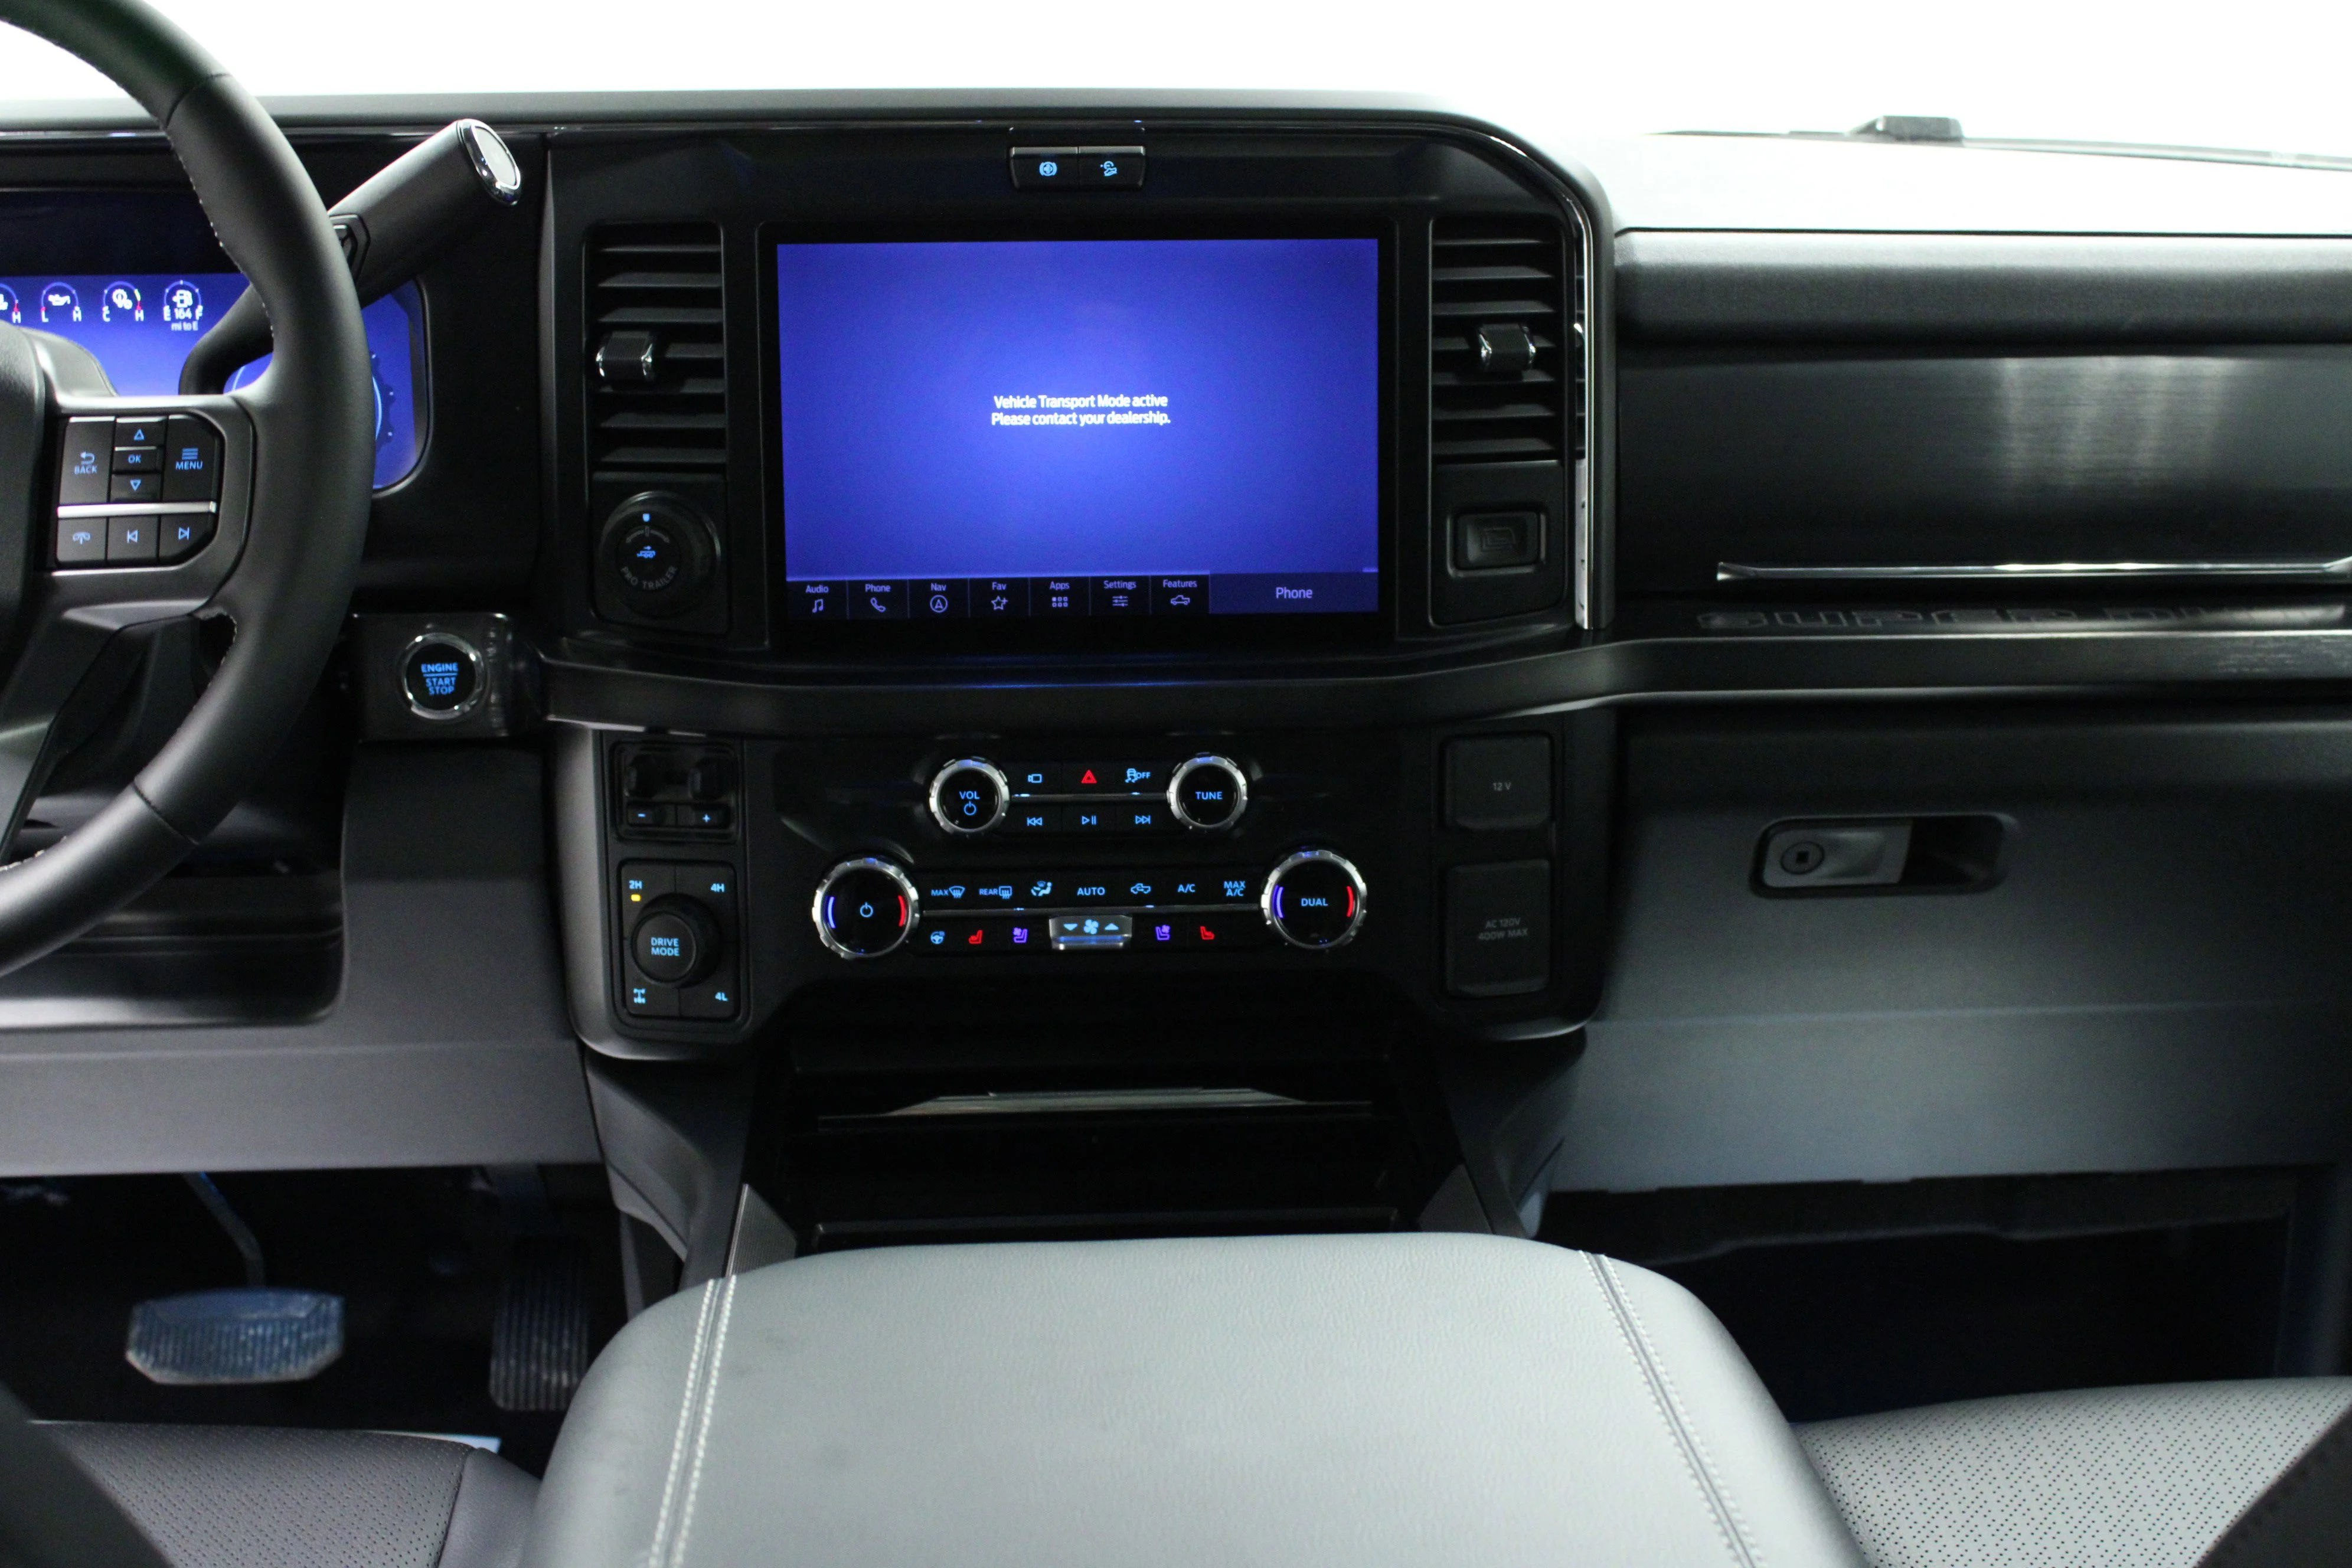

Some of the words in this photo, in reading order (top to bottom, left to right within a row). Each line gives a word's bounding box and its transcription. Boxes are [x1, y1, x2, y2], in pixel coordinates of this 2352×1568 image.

[41, 311, 48, 322] L
[135, 309, 144, 321] H
[174, 308, 192, 320] 164
[171, 321, 182, 331] mi
[182, 321, 191, 331] to
[192, 321, 199, 331] E
[994, 396, 1036, 409] Vehicle
[1038, 395, 1095, 410] Transport
[1097, 394, 1130, 407] Mode
[1132, 394, 1168, 407] active
[992, 413, 1030, 425] Please
[1033, 413, 1077, 425] contact
[1079, 414, 1106, 426] your
[1106, 410, 1171, 426] dealership.
[128, 454, 142, 463] OK
[74, 465, 97, 475] BACK
[175, 461, 203, 470] MENU
[865, 583, 891, 592] Phone
[930, 583, 947, 591] Nav
[992, 582, 1007, 591] Fav
[1049, 581, 1070, 591] Apps
[1103, 580, 1136, 590] Settings
[1162, 579, 1198, 588] Features
[805, 584, 829, 593] Audio
[1276, 587, 1313, 599] Phone
[421, 662, 458, 673] ENGINE
[426, 677, 456, 687] START
[429, 687, 455, 695] STOP
[1136, 770, 1151, 779] OFF
[959, 790, 980, 800] VOL
[1195, 791, 1223, 800] TUNE
[629, 880, 642, 889] 2H
[710, 883, 725, 893] 4H
[1177, 884, 1195, 893] A/C
[1077, 887, 1106, 896] AUTO
[1301, 897, 1328, 907] DUAL
[1508, 928, 1528, 936] MAX
[651, 937, 679, 947] DRIVE
[651, 947, 680, 956] MODE
[715, 992, 728, 1001] 4L
